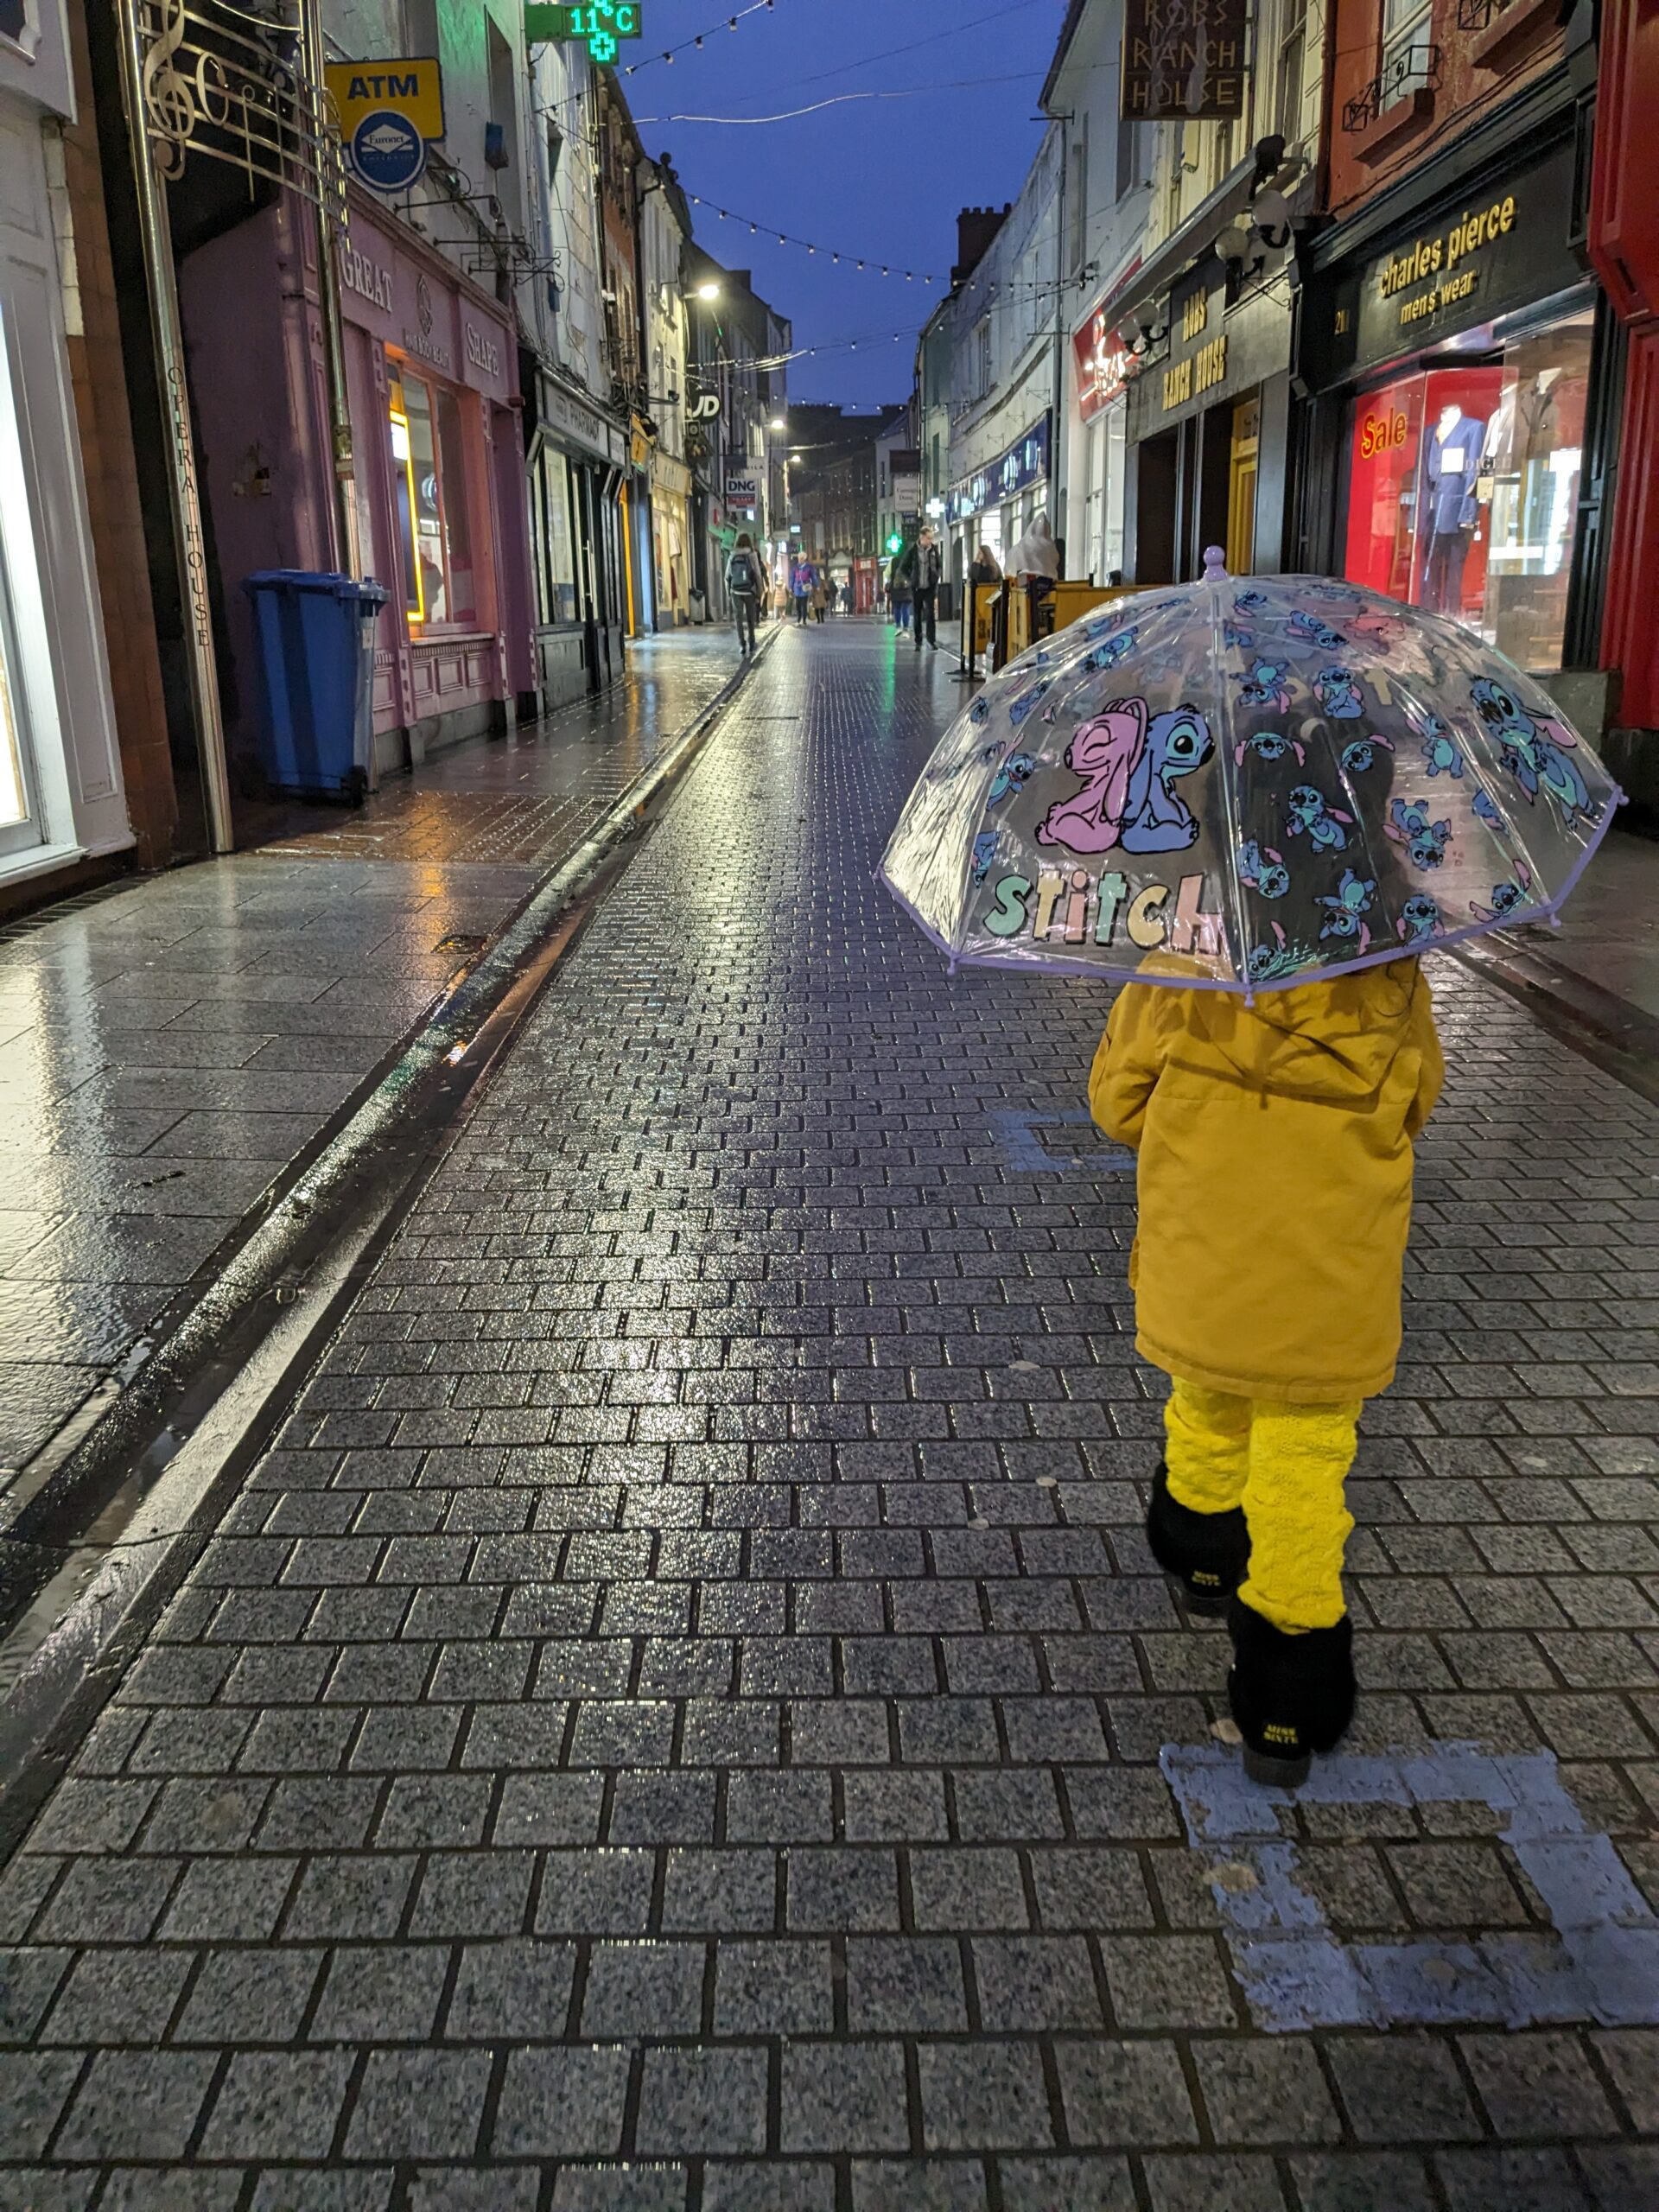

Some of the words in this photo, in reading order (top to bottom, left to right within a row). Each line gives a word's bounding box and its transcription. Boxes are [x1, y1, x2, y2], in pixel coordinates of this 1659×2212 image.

[570, 6, 633, 33] 11°C
[1134, 37, 1236, 71] RANCH
[347, 73, 419, 100] ATM
[1132, 78, 1236, 108] HOUSE
[369, 134, 404, 144] Euronet
[1380, 238, 1442, 298] charles
[1447, 197, 1515, 270] pierce
[340, 247, 392, 314] GREAT
[1441, 269, 1477, 306] wear
[467, 322, 499, 377] SHAPE
[1163, 359, 1192, 411] RANCH
[1196, 334, 1227, 394] HOUSE
[692, 395, 720, 418] JD
[1361, 407, 1407, 460] Sale
[728, 480, 755, 492] DNG
[168, 366, 195, 493] OPERA
[185, 524, 210, 646] HOUSE
